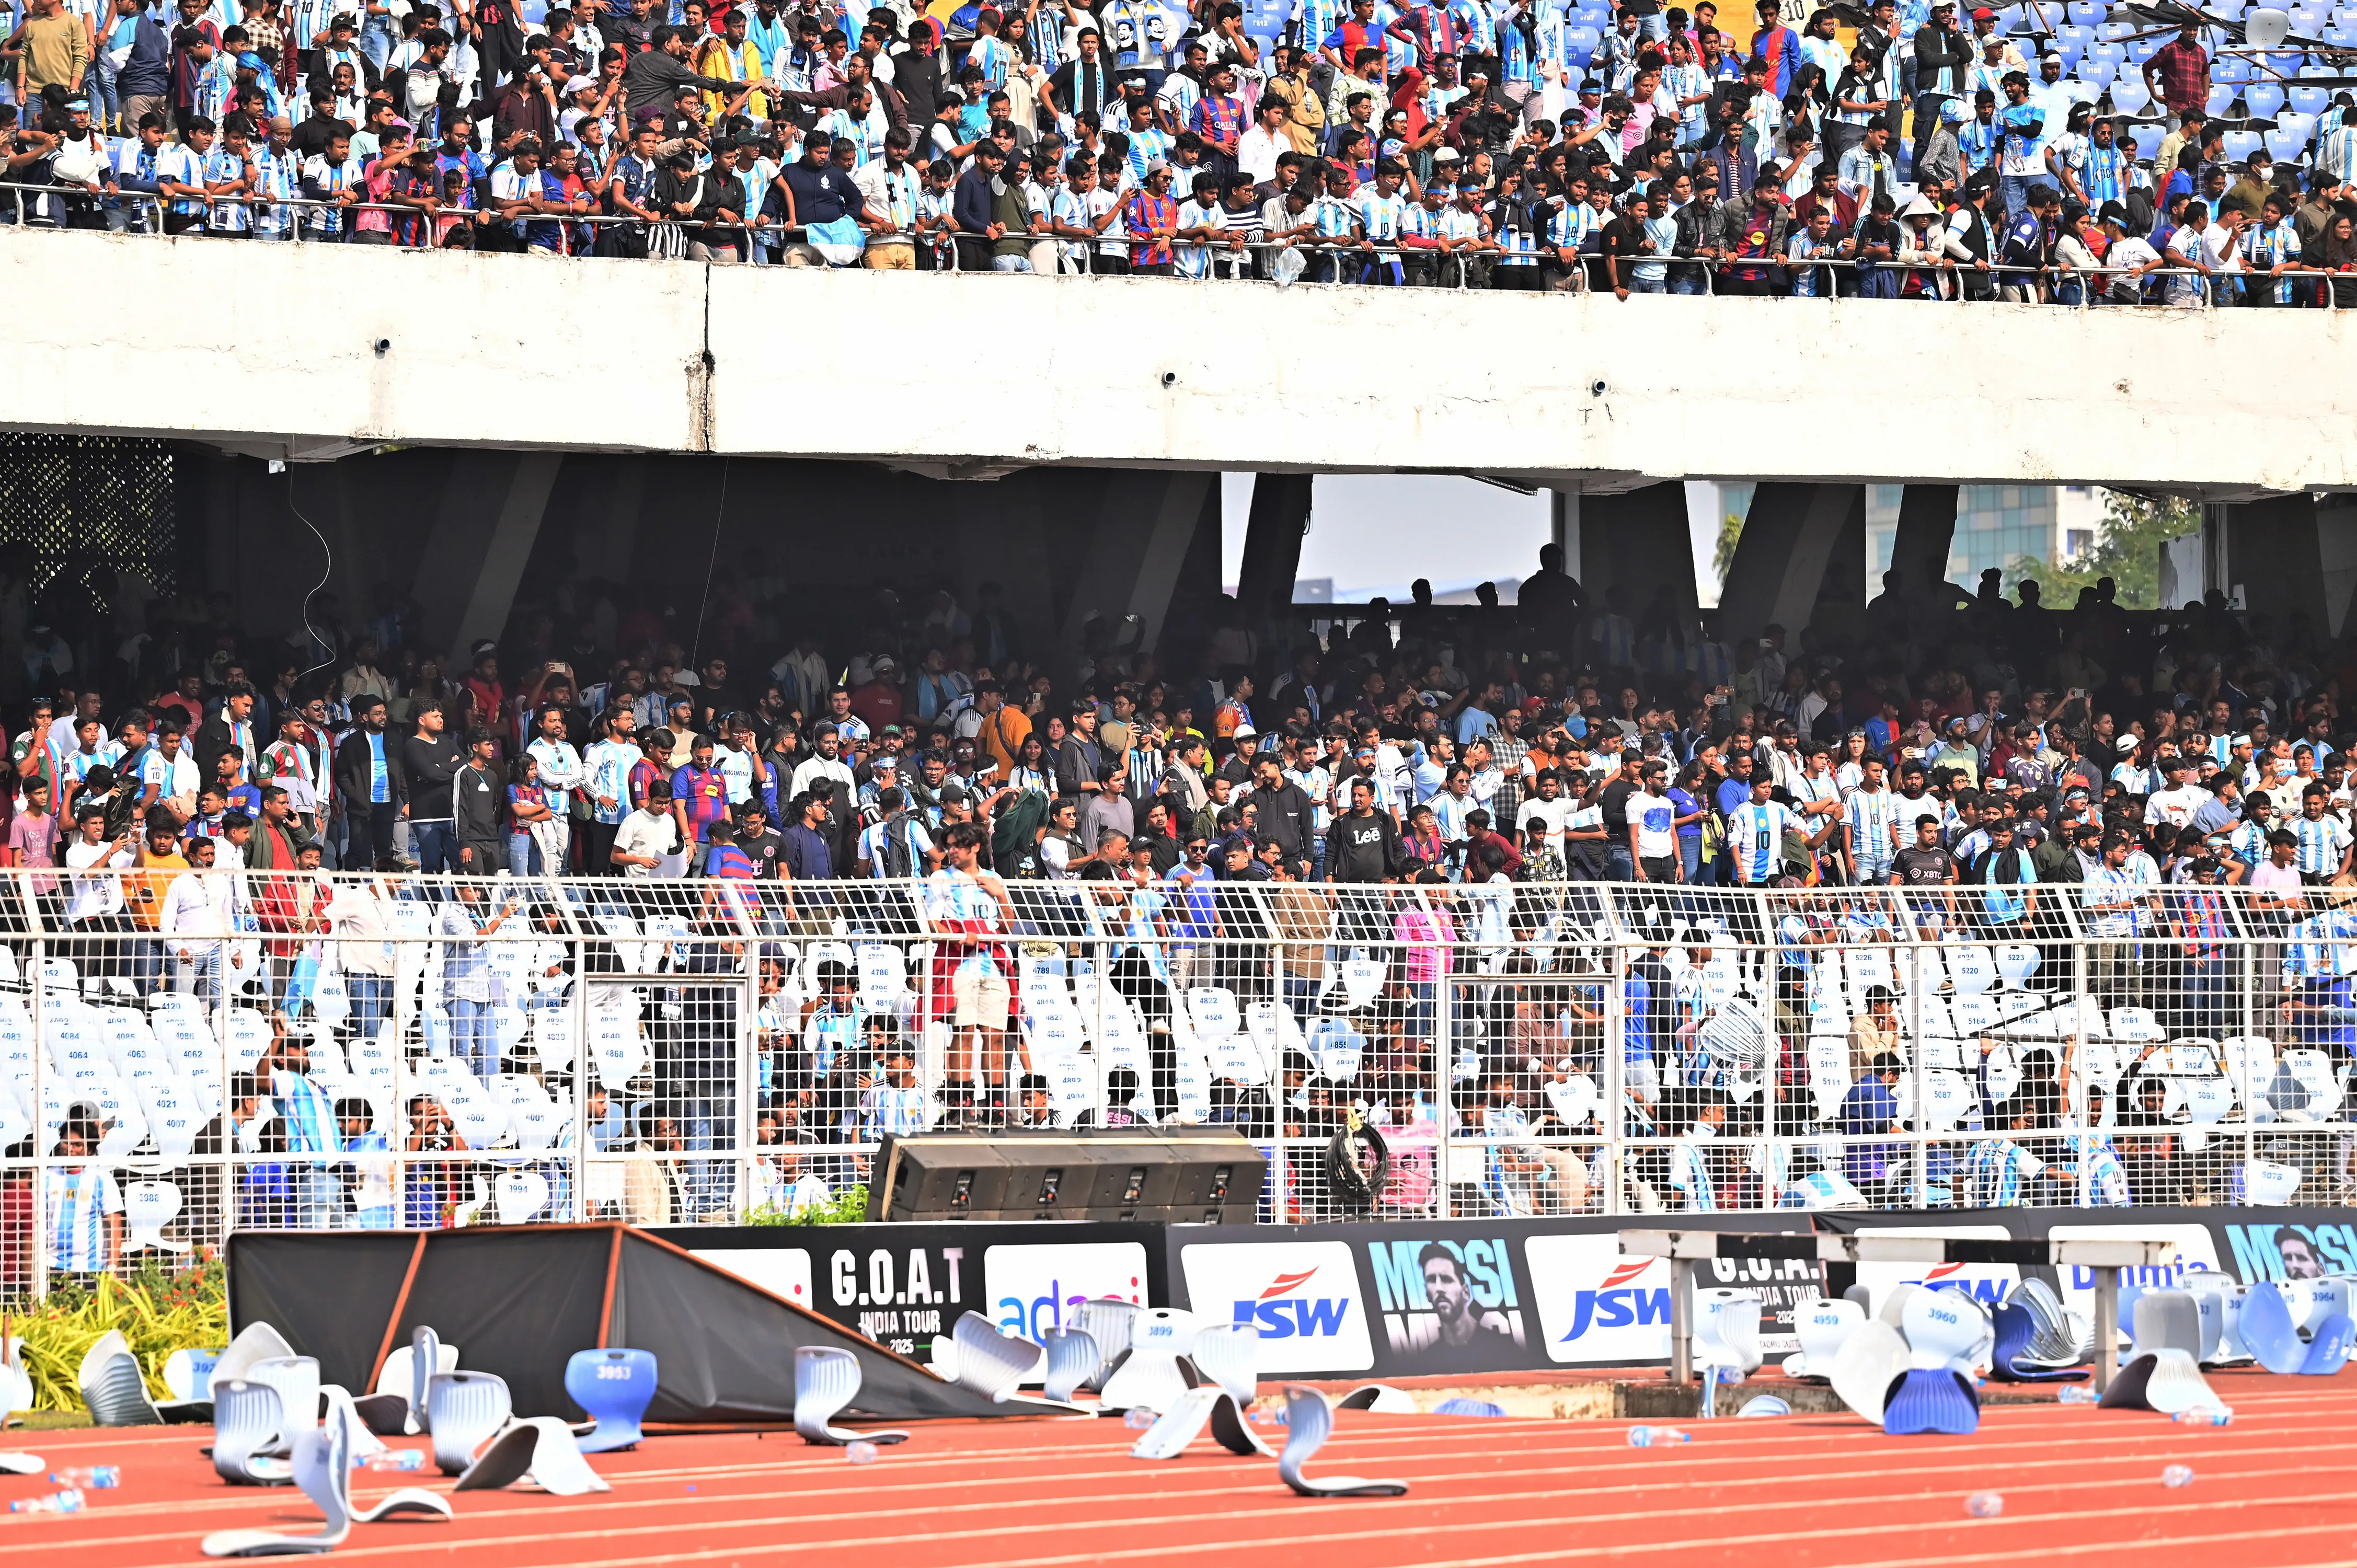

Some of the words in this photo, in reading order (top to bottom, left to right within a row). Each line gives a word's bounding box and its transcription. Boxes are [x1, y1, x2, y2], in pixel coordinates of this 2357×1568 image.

[302, 1, 313, 13] 10
[1785, 1, 1803, 21] 10
[1322, 19, 1333, 32] 10
[1381, 225, 1388, 236] 10
[1567, 227, 1576, 237] 10
[1611, 236, 1616, 246] 3
[1870, 814, 1879, 825] 10
[1353, 829, 1380, 844] Lee
[1755, 831, 1769, 850] 10
[496, 953, 515, 961] 4769
[492, 970, 511, 978] 4779
[1962, 967, 1979, 975] 5220
[323, 987, 341, 996] 4806
[1204, 1013, 1223, 1021] 4824
[60, 1032, 80, 1040] 4084
[127, 1050, 146, 1058] 4063
[362, 1050, 382, 1058] 4059
[605, 1050, 624, 1058] 4868
[1821, 1061, 1838, 1069] 5117
[2294, 1059, 2312, 1068] 5126
[370, 1067, 389, 1076] 4057
[1934, 1091, 1951, 1099] 5087
[2198, 1091, 2215, 1100] 5092
[100, 1101, 119, 1109] 4020
[156, 1100, 177, 1108] 4021
[466, 1113, 486, 1122] 4002
[526, 1113, 545, 1122] 4001
[1105, 1111, 1132, 1124] ESSI
[1135, 1109, 1155, 1117] 4923
[166, 1120, 186, 1128] 4007
[508, 1183, 528, 1194] 3994
[2312, 1292, 2335, 1302] 3964
[1927, 1307, 1958, 1325] 3960
[903, 1310, 940, 1333] TOUR
[890, 1339, 914, 1354] 2025
